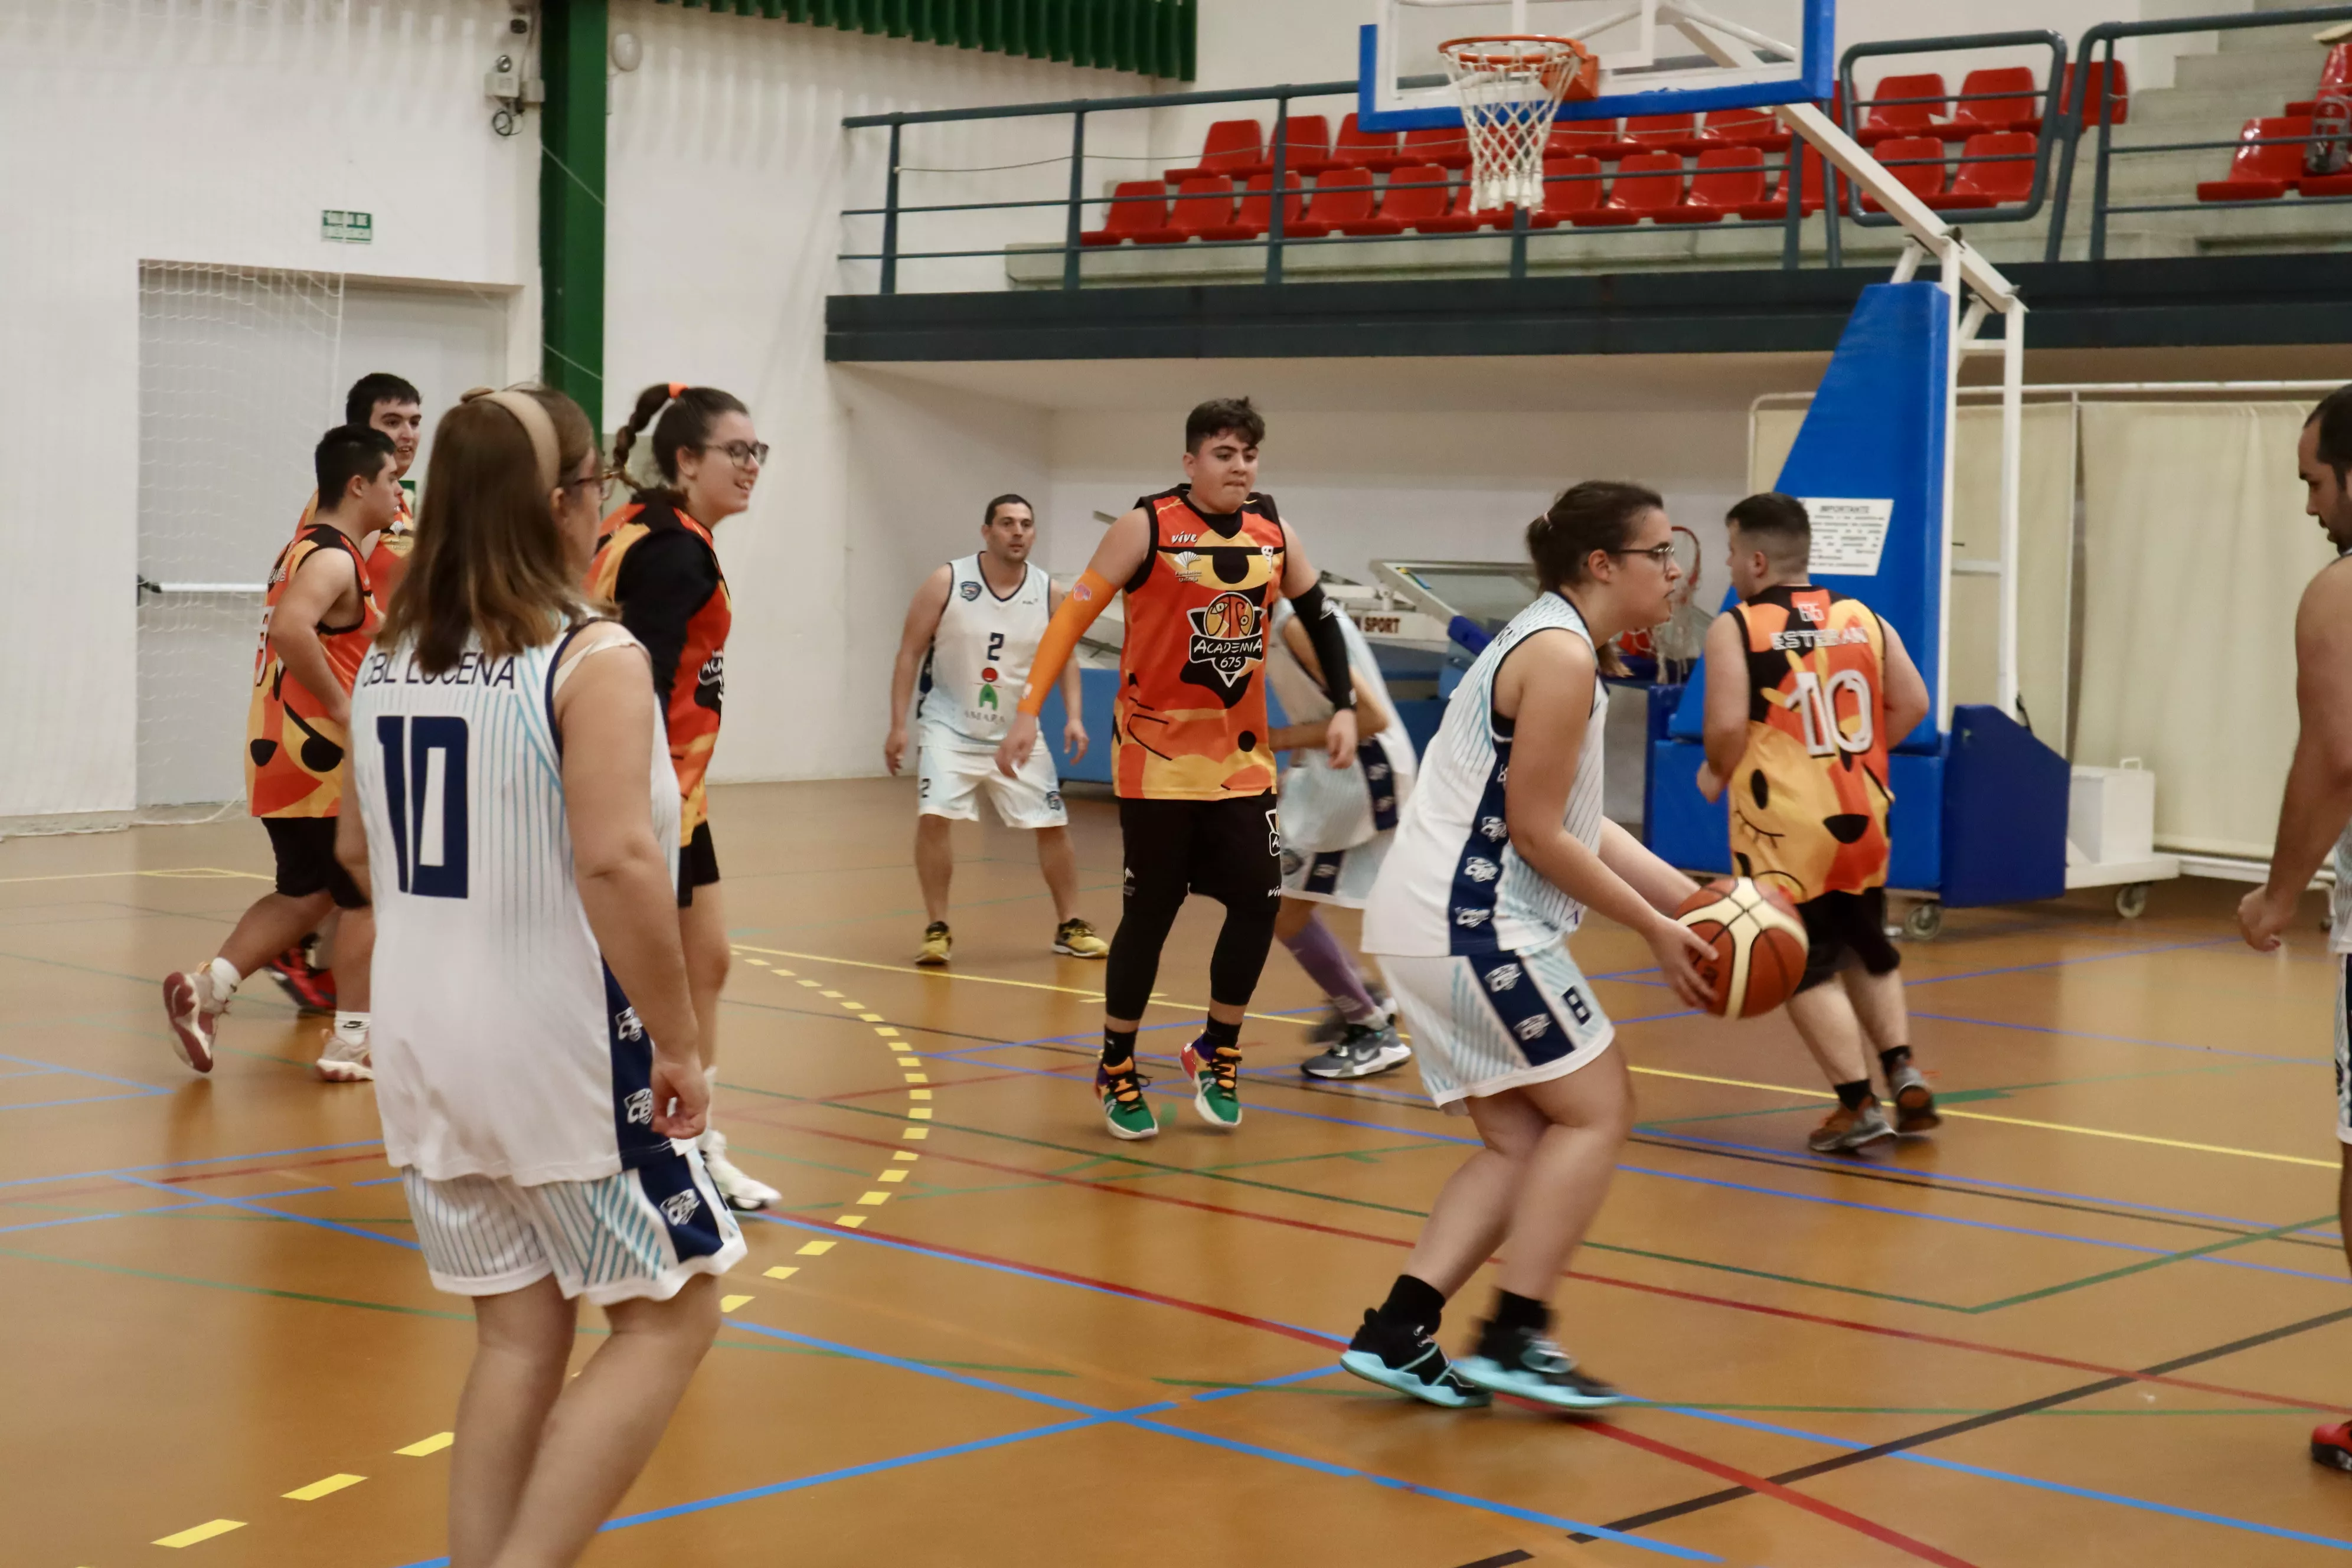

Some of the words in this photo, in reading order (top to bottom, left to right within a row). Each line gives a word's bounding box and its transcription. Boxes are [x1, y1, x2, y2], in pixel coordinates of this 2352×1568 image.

[1364, 617, 1400, 633] SPORT
[987, 632, 1005, 661] 2
[1194, 638, 1263, 654] ACADEMIA
[1220, 656, 1242, 668] 675
[406, 651, 515, 690] LENA
[1784, 668, 1874, 756] 10
[377, 715, 469, 899] 10
[1561, 985, 1592, 1027] 8
